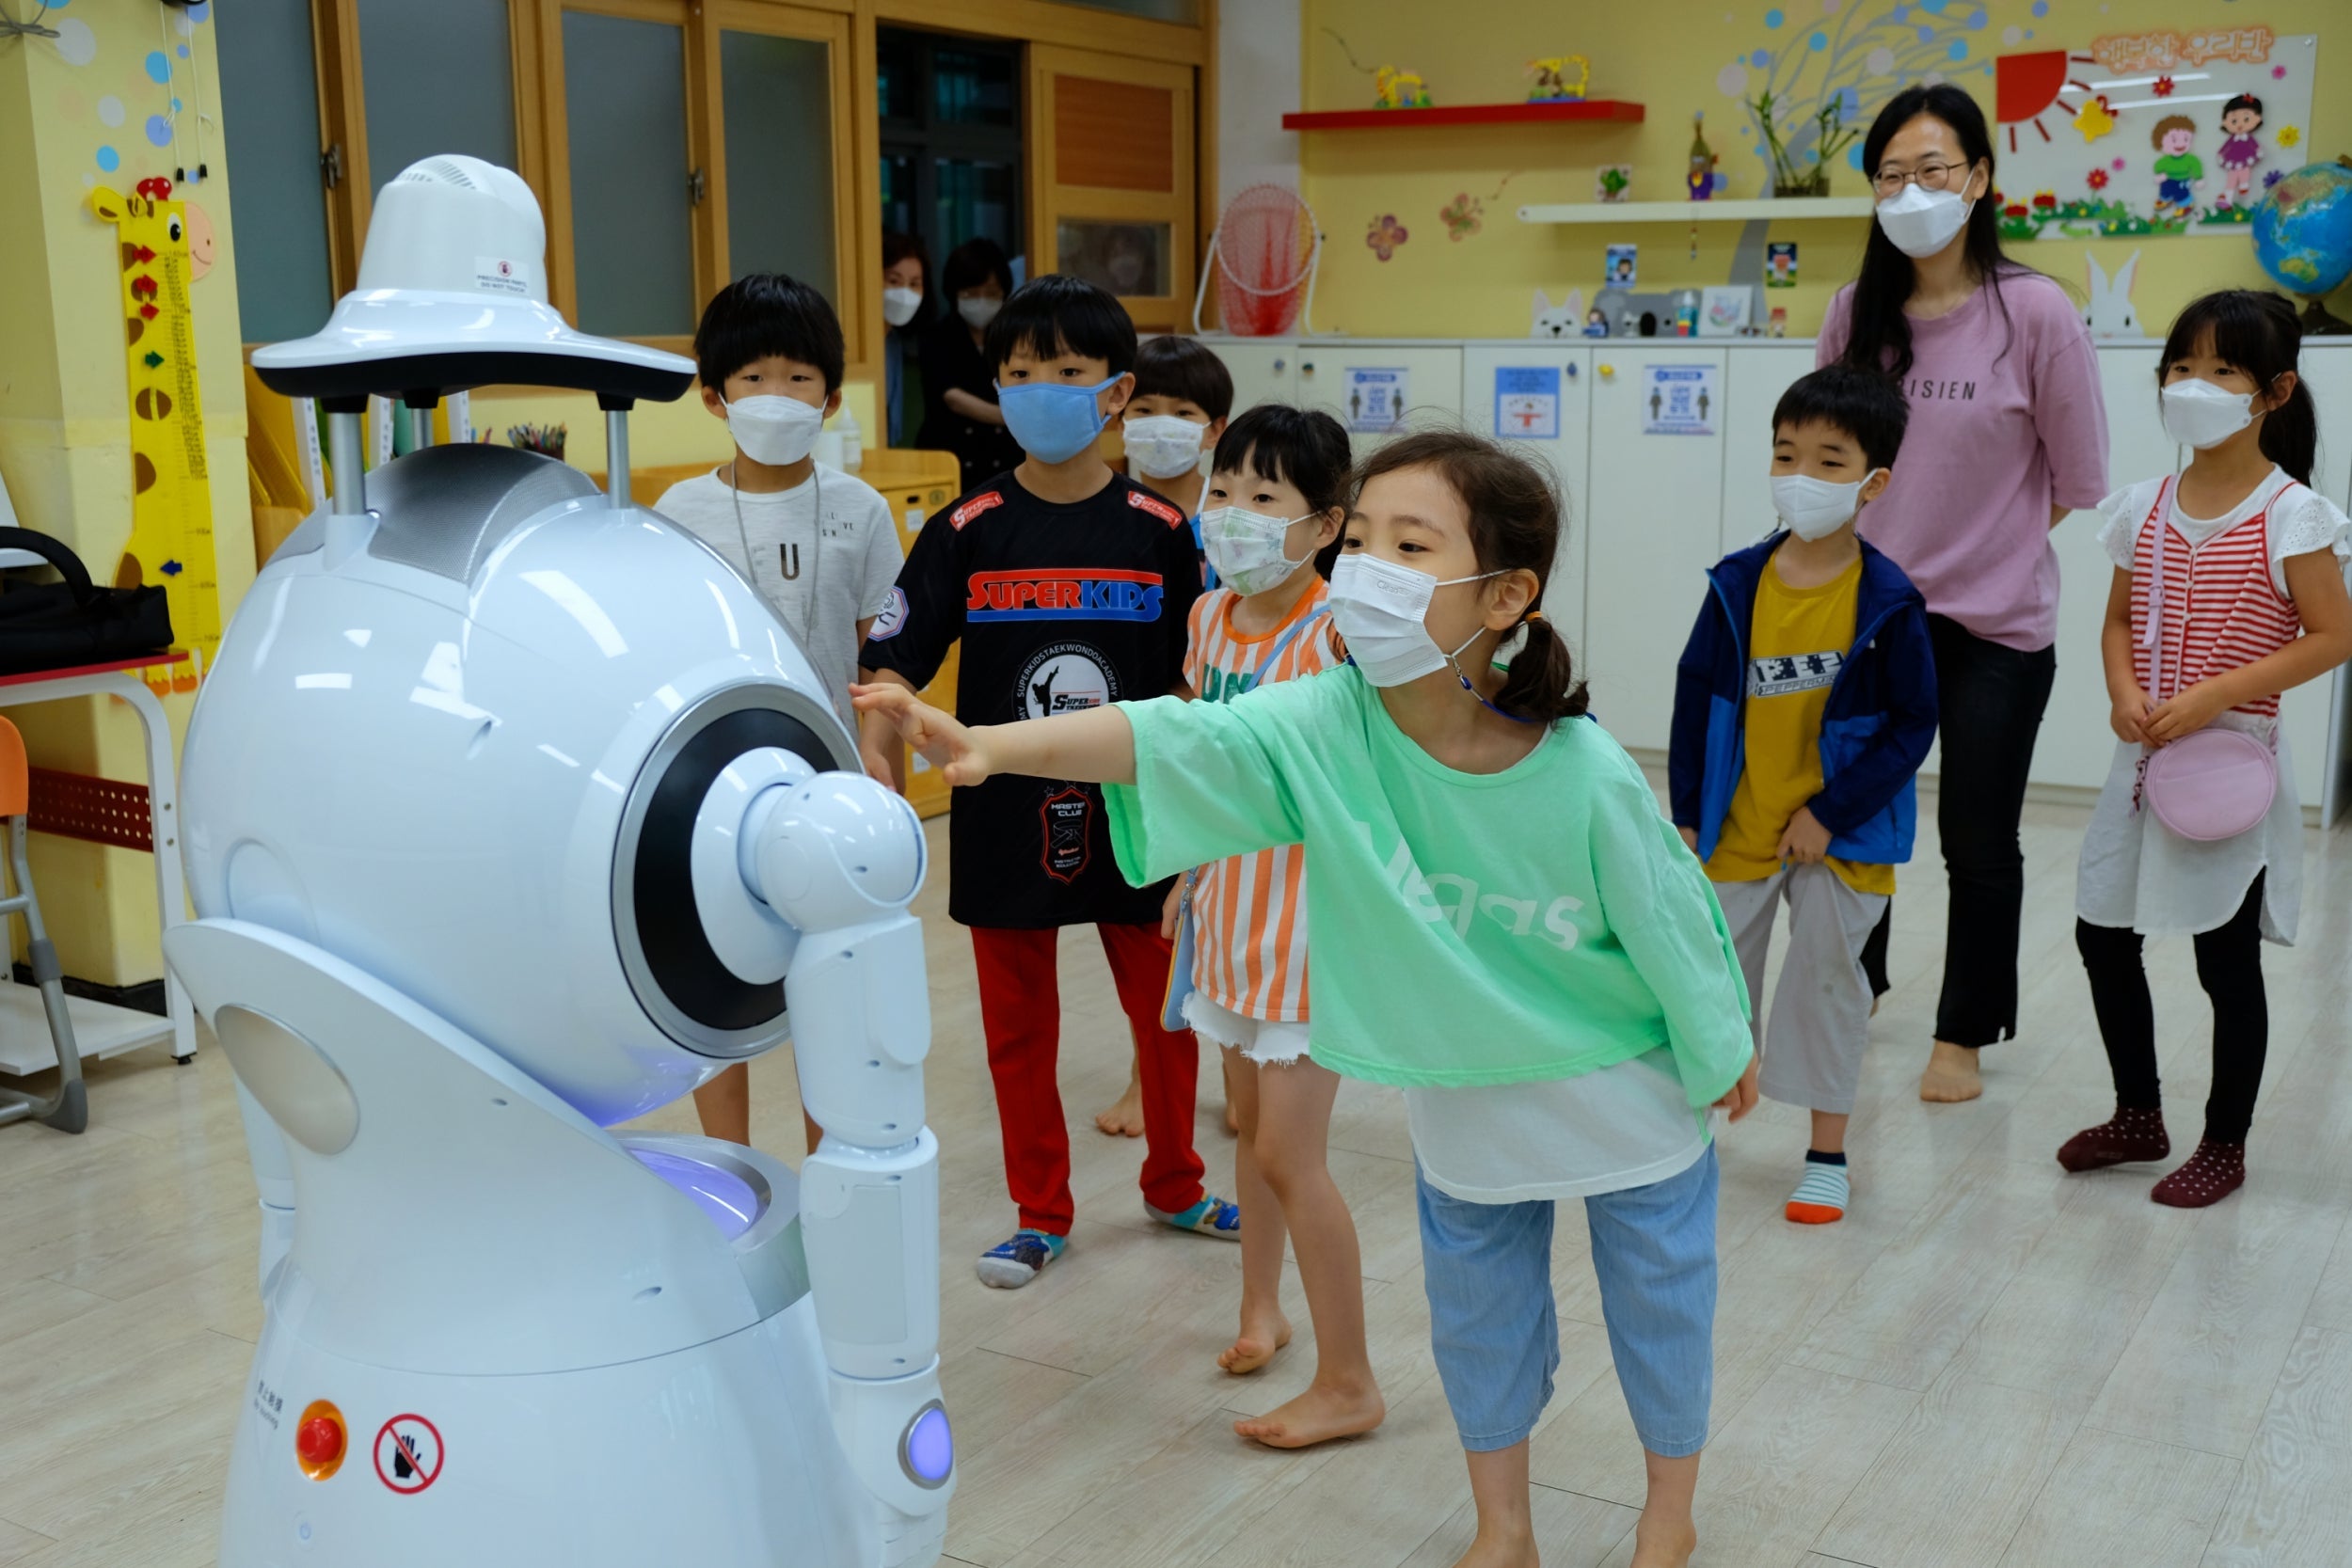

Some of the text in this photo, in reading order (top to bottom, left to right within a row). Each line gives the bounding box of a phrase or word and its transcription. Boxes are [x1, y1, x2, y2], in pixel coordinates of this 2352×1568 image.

[2185, 26, 2273, 67] 우리반
[779, 543, 800, 580] U
[967, 568, 1164, 623] SUPERKIDS
